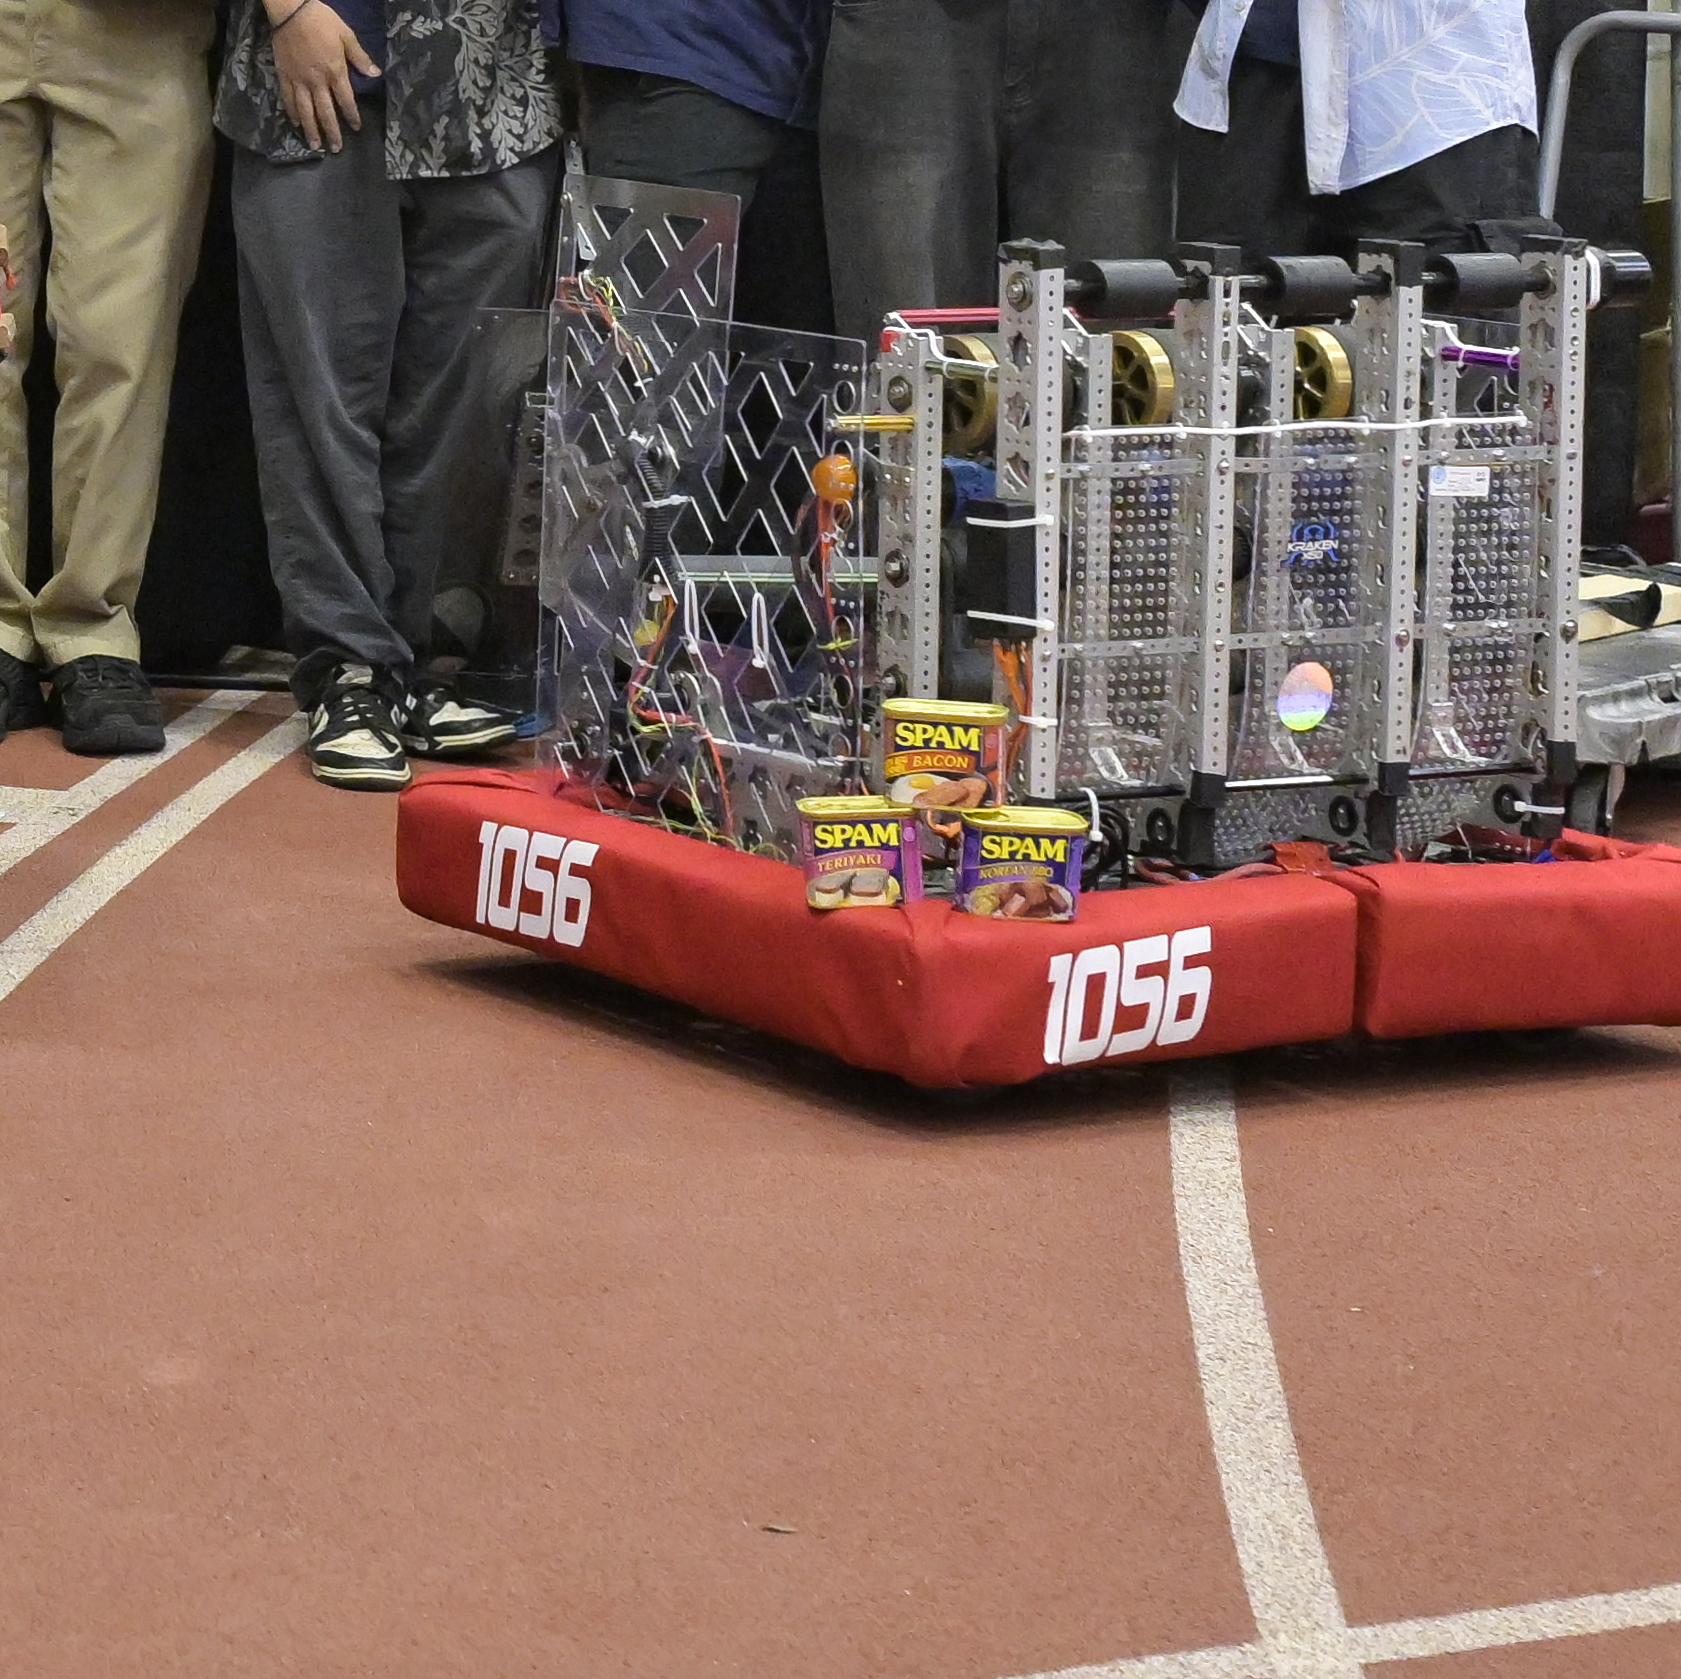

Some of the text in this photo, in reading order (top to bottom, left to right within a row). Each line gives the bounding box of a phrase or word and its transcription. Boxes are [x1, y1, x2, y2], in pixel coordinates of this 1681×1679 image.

[1287, 540, 1339, 552] KRAKEN
[895, 722, 980, 751] SPAM
[912, 755, 969, 768] BACON
[815, 823, 899, 848] SPAM
[980, 835, 1066, 862] SPAM
[818, 854, 882, 872] TERIYAKI
[980, 866, 1027, 878] KOREAN
[475, 820, 600, 948] 1056
[1043, 924, 1212, 1068] 1056
